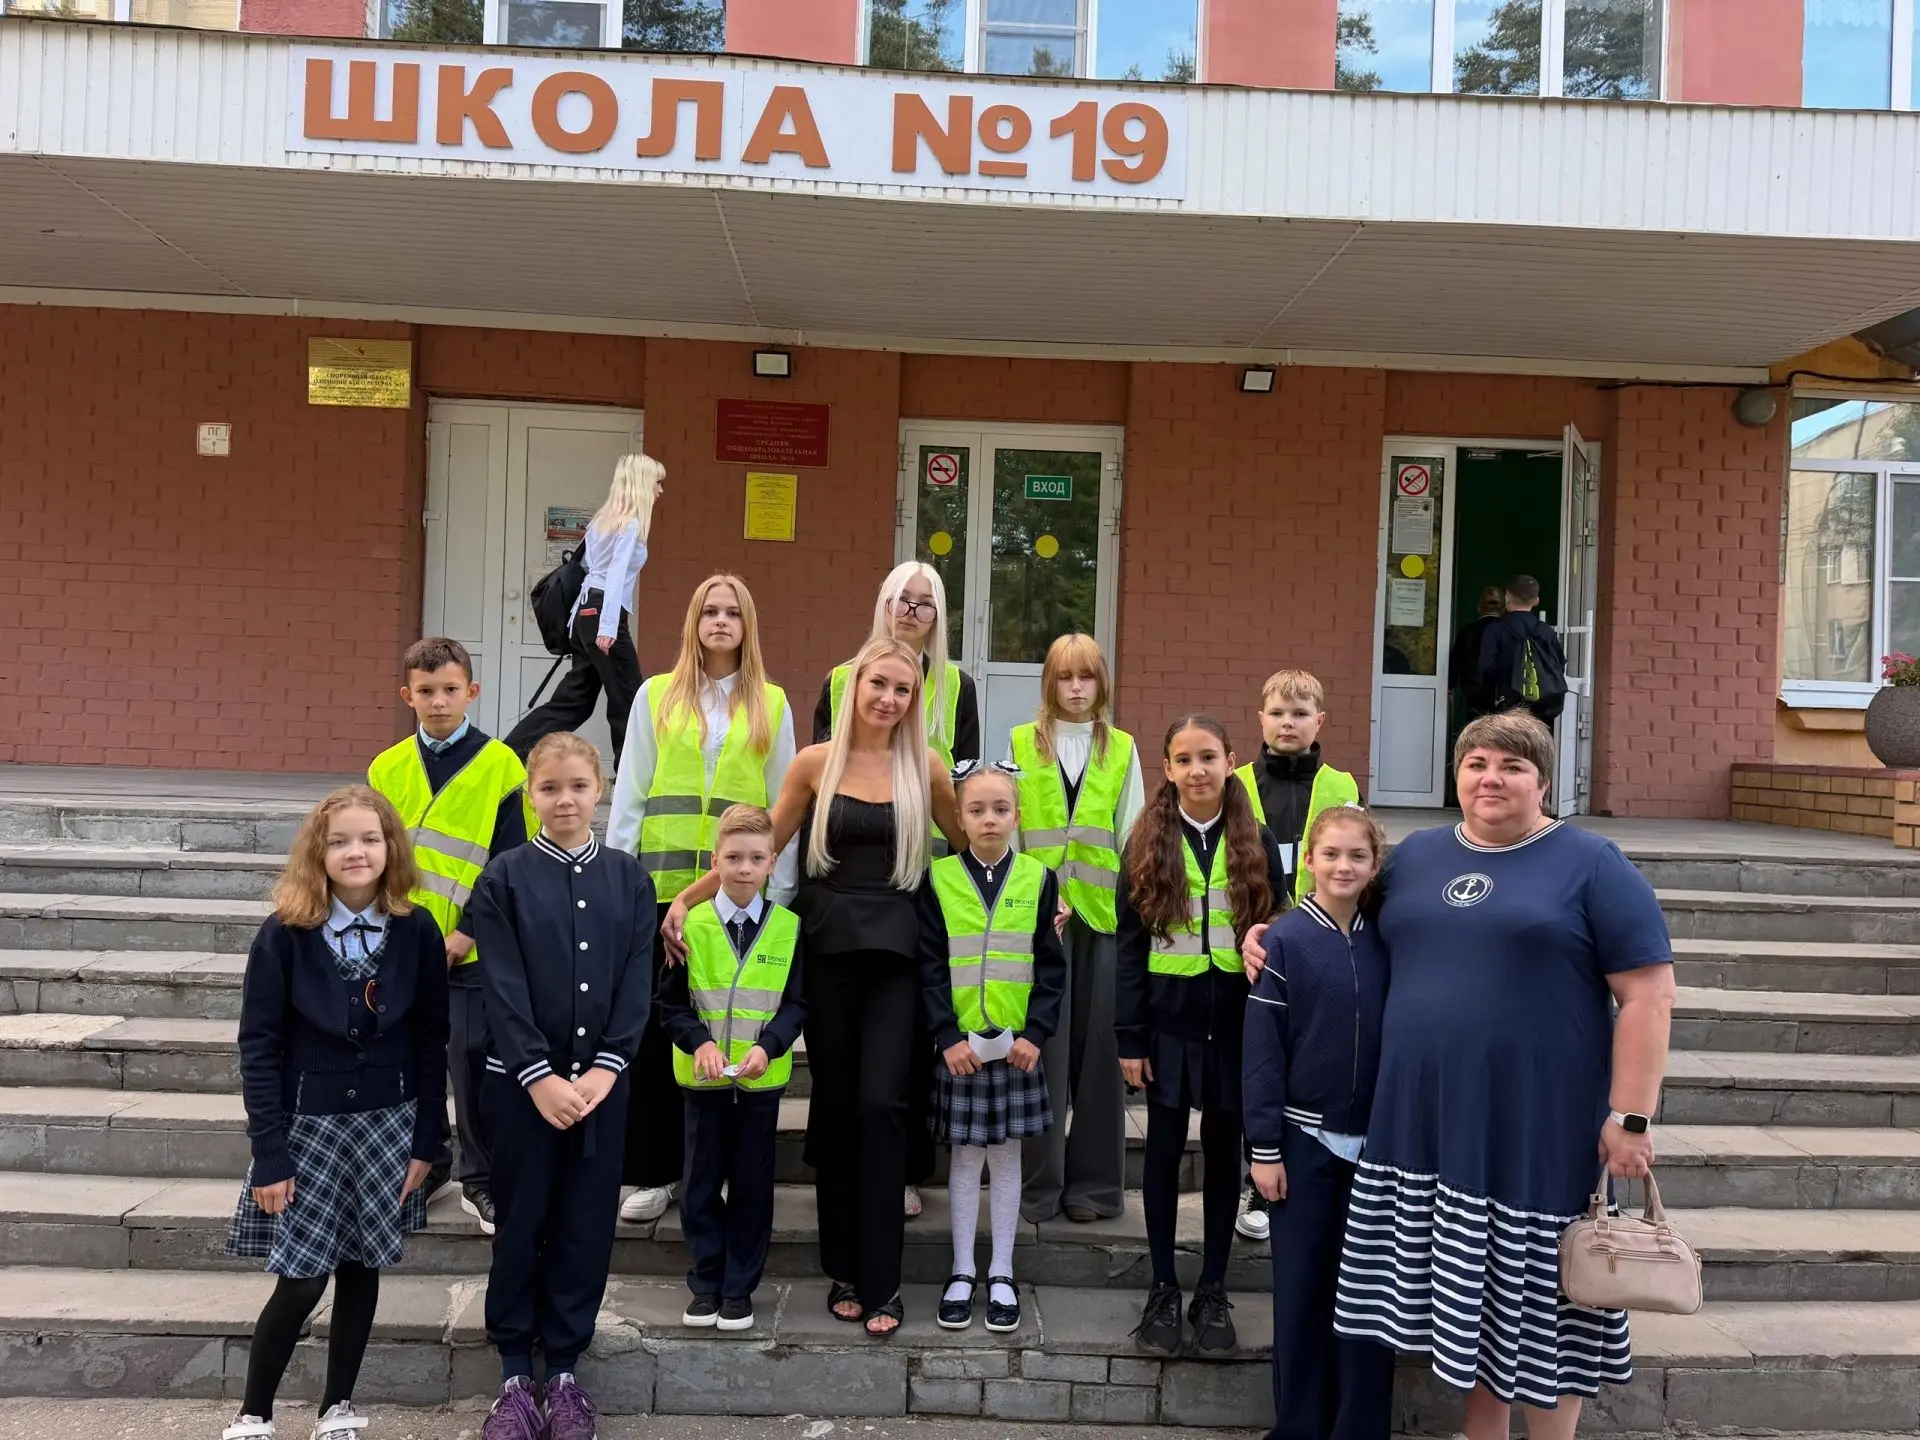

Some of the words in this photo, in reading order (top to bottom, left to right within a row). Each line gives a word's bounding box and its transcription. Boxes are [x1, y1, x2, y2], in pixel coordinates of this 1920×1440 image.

[304, 57, 831, 167] ШКОЛА
[892, 92, 1169, 183] №19
[207, 427, 220, 436] ПГ
[726, 445, 817, 456] ОБЩЕОБРАЗОВАТЕЛЬНАЯ
[1033, 481, 1065, 495] ВХОД
